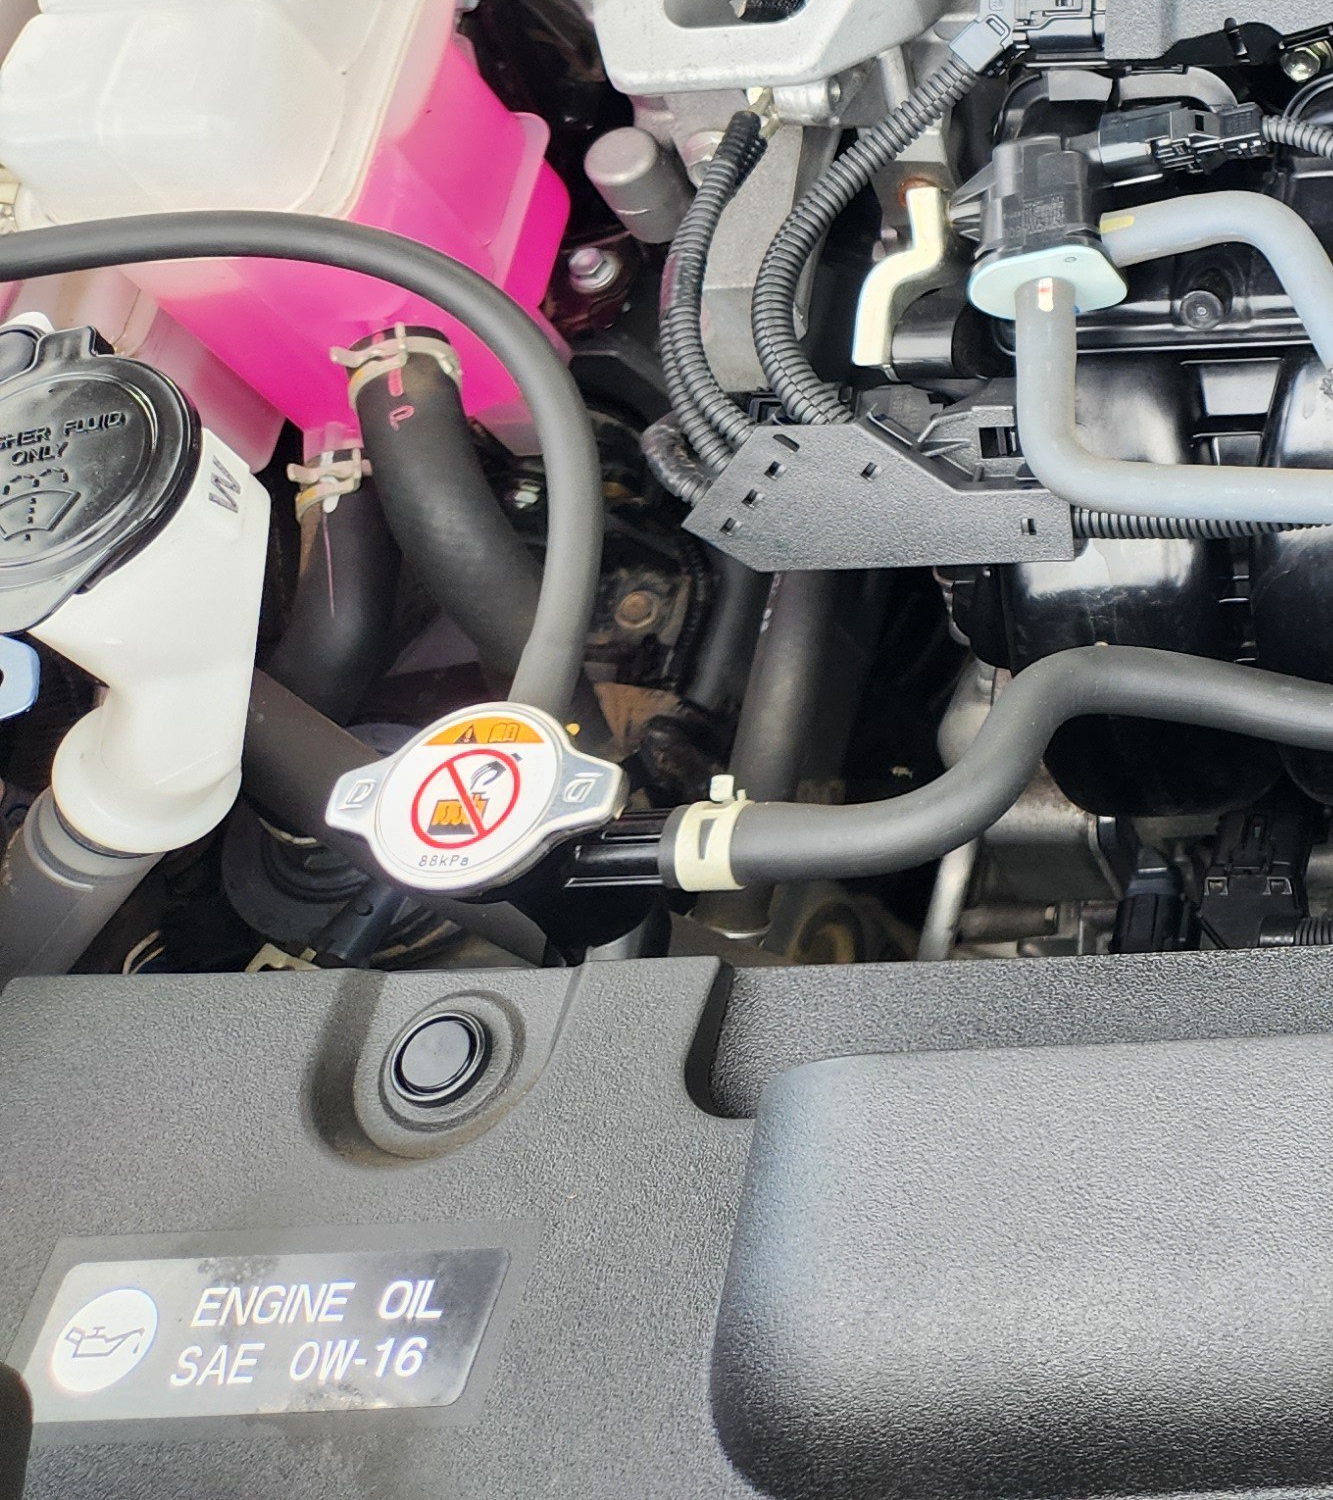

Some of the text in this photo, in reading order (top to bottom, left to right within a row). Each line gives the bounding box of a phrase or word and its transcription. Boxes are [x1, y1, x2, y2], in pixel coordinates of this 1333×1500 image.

[63, 411, 127, 437] FLUID
[11, 441, 69, 467] ONLY
[418, 854, 470, 868] 88kPa
[190, 1278, 444, 1328] ENGINE OIL
[169, 1342, 266, 1388] SAE
